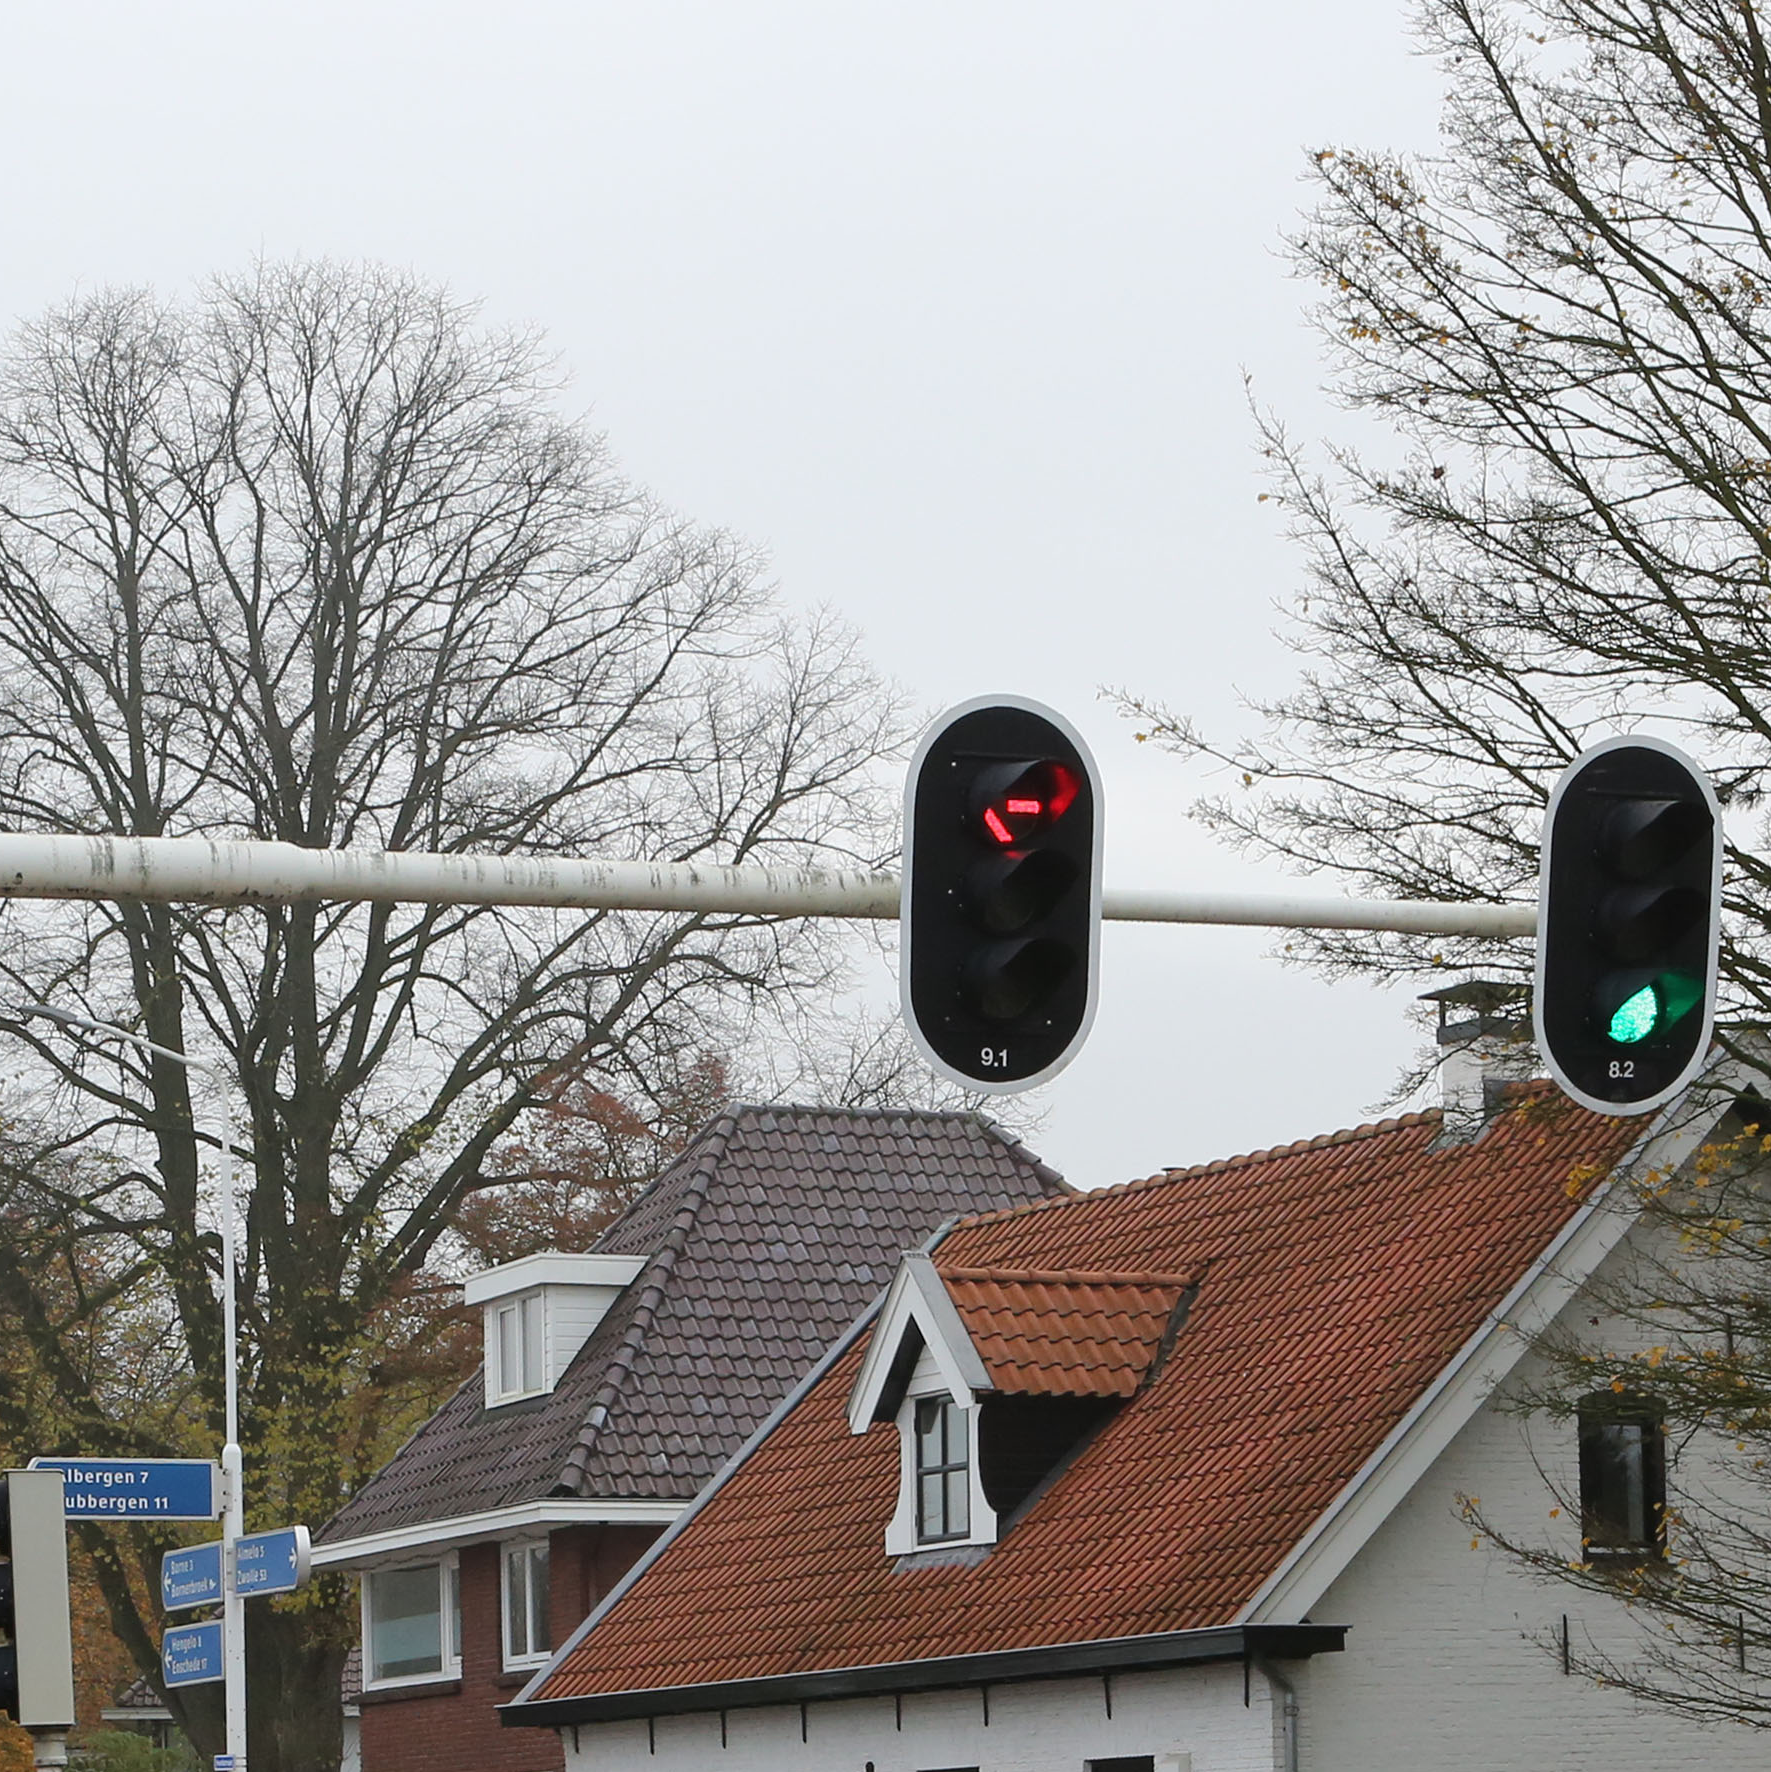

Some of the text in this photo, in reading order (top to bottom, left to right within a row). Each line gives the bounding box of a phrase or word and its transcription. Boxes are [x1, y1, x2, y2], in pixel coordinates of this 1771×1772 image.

[980, 1047, 1008, 1067] 9.1
[1608, 1060, 1635, 1078] 8.2
[140, 1471, 149, 1484] 7
[65, 1494, 169, 1513] ubbergen 11
